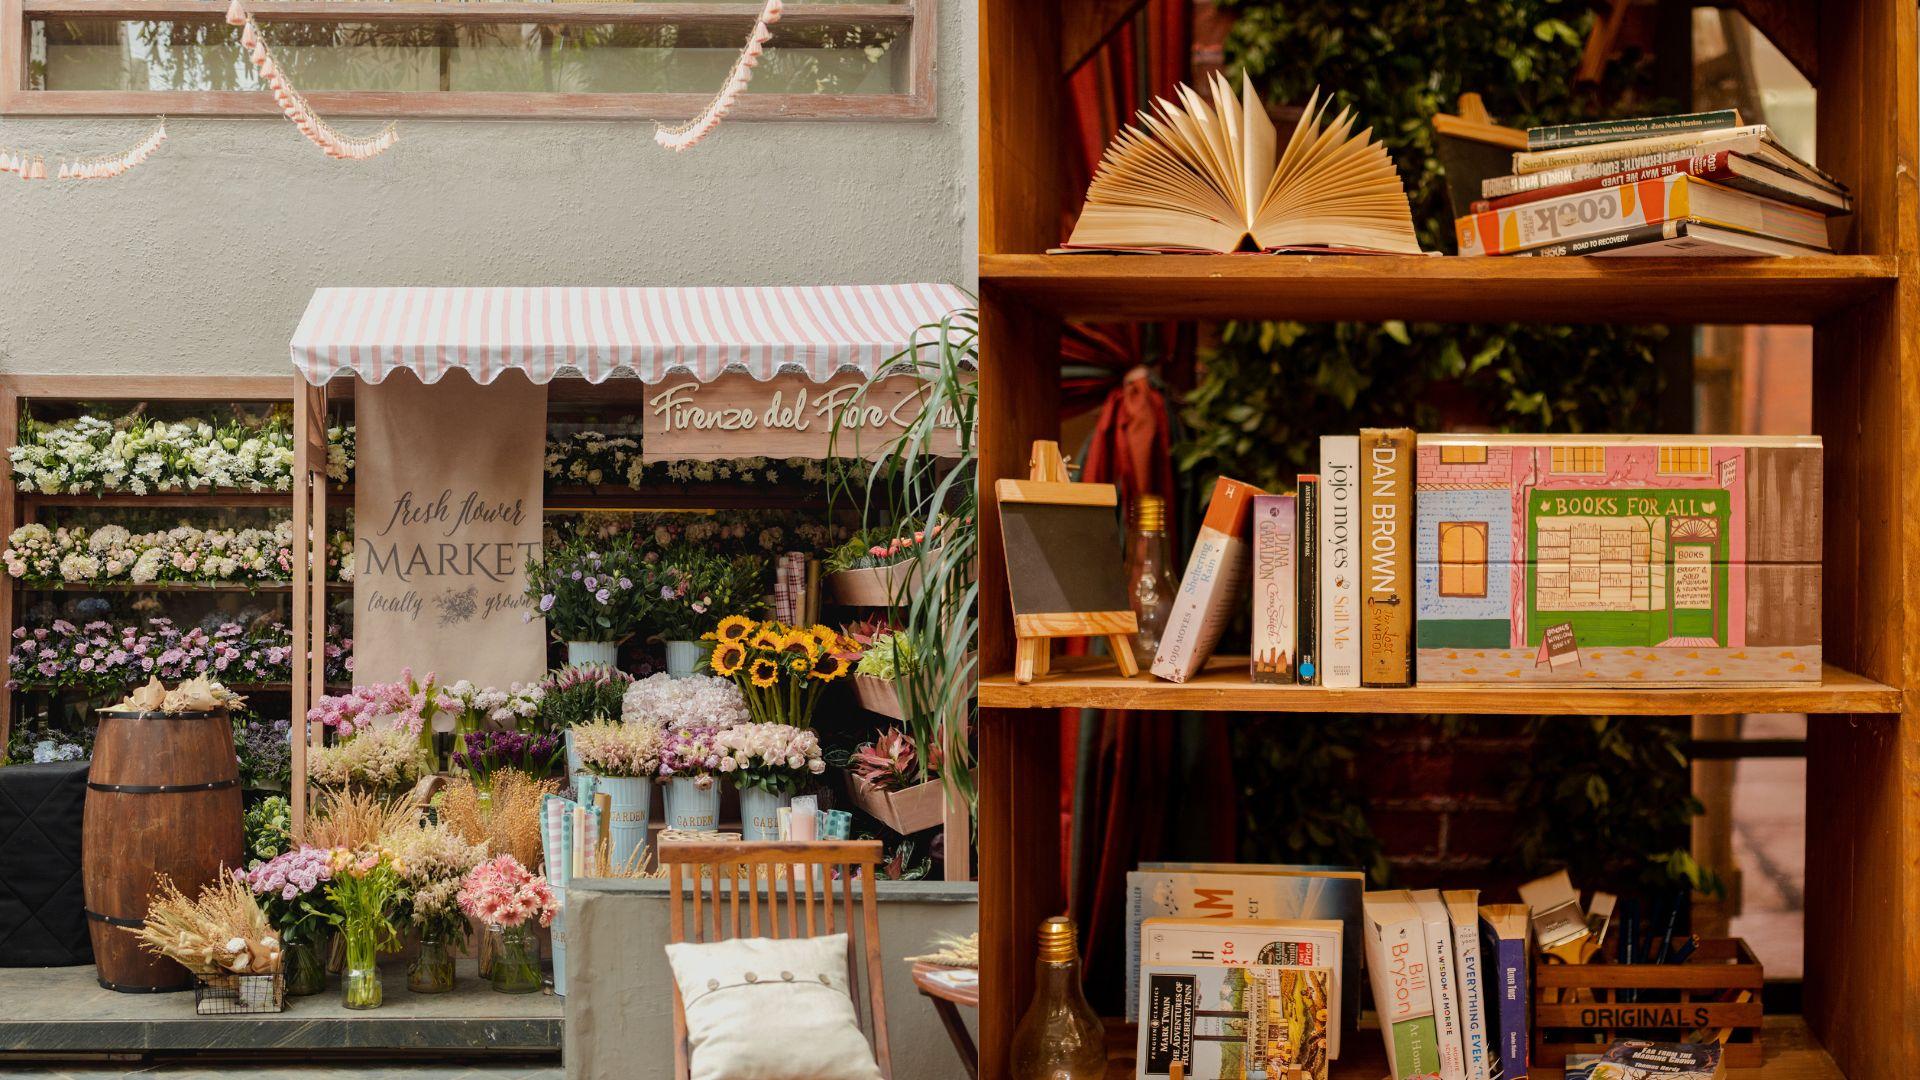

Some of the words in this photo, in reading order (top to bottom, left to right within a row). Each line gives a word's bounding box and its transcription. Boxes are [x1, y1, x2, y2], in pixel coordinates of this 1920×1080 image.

[1522, 157, 1547, 169] Sarah
[1641, 168, 1659, 179] WAY
[1662, 165, 1677, 176] THE
[1519, 173, 1540, 189] WAR
[1540, 169, 1573, 187] WORLD
[1602, 176, 1624, 187] LIVED
[1626, 172, 1639, 182] WE
[1573, 241, 1590, 251] ROAD
[1590, 240, 1599, 248] TO
[1598, 234, 1629, 247] RECOVERY
[650, 382, 758, 431] Firenze
[763, 388, 810, 431] del
[812, 383, 889, 431] Fiore
[1328, 461, 1352, 500] jojo
[1372, 448, 1397, 497] DAN
[377, 488, 452, 537] fresh
[443, 490, 527, 537] flower
[1556, 497, 1618, 515] BOOKS
[1626, 497, 1660, 516] FOR
[1665, 499, 1699, 516] ALL
[1328, 505, 1348, 568] moyes
[1372, 504, 1396, 592] BROWN
[360, 538, 544, 583] MARKET
[1260, 521, 1276, 580] GABALDON
[1275, 531, 1291, 568] DIANA
[1678, 551, 1704, 560] BOOKS
[1185, 543, 1214, 595] Sheltering
[1201, 559, 1216, 583] Rain
[367, 590, 423, 620] locally
[482, 592, 533, 620] grown
[1334, 596, 1349, 621] Still
[1176, 613, 1191, 644] MOYES
[1334, 626, 1349, 650] Me
[1371, 608, 1382, 656] SYMBOL
[1382, 627, 1399, 657] Lost
[676, 815, 713, 827] GARDEN
[1134, 887, 1142, 916] THRILLER
[1304, 943, 1312, 965] Price
[1390, 943, 1411, 1014] Bryson
[1409, 963, 1425, 990] Bill
[1439, 955, 1448, 991] WISDOM
[1507, 967, 1517, 985] OLIVER
[1175, 982, 1182, 993] OF
[1184, 984, 1192, 1005] FINN
[1442, 992, 1449, 1001] of
[1507, 985, 1517, 1000] TWIST
[1162, 997, 1171, 1025] TWAIN
[1172, 994, 1182, 1049] ADVENTURES
[1443, 1002, 1453, 1035] MORRIE
[1581, 1008, 1709, 1027] ORIGINALS
[1160, 1026, 1169, 1052] MARK
[1182, 1006, 1191, 1066] HUCKLEBERRY
[1409, 1024, 1419, 1038] At
[1411, 1040, 1422, 1074] Home
[1632, 1052, 1667, 1062] MADDING
[1668, 1056, 1696, 1065] CROWD
[1640, 1047, 1657, 1055] FAR
[1635, 1062, 1659, 1070] Thomas
[1660, 1065, 1680, 1073] Hardy
